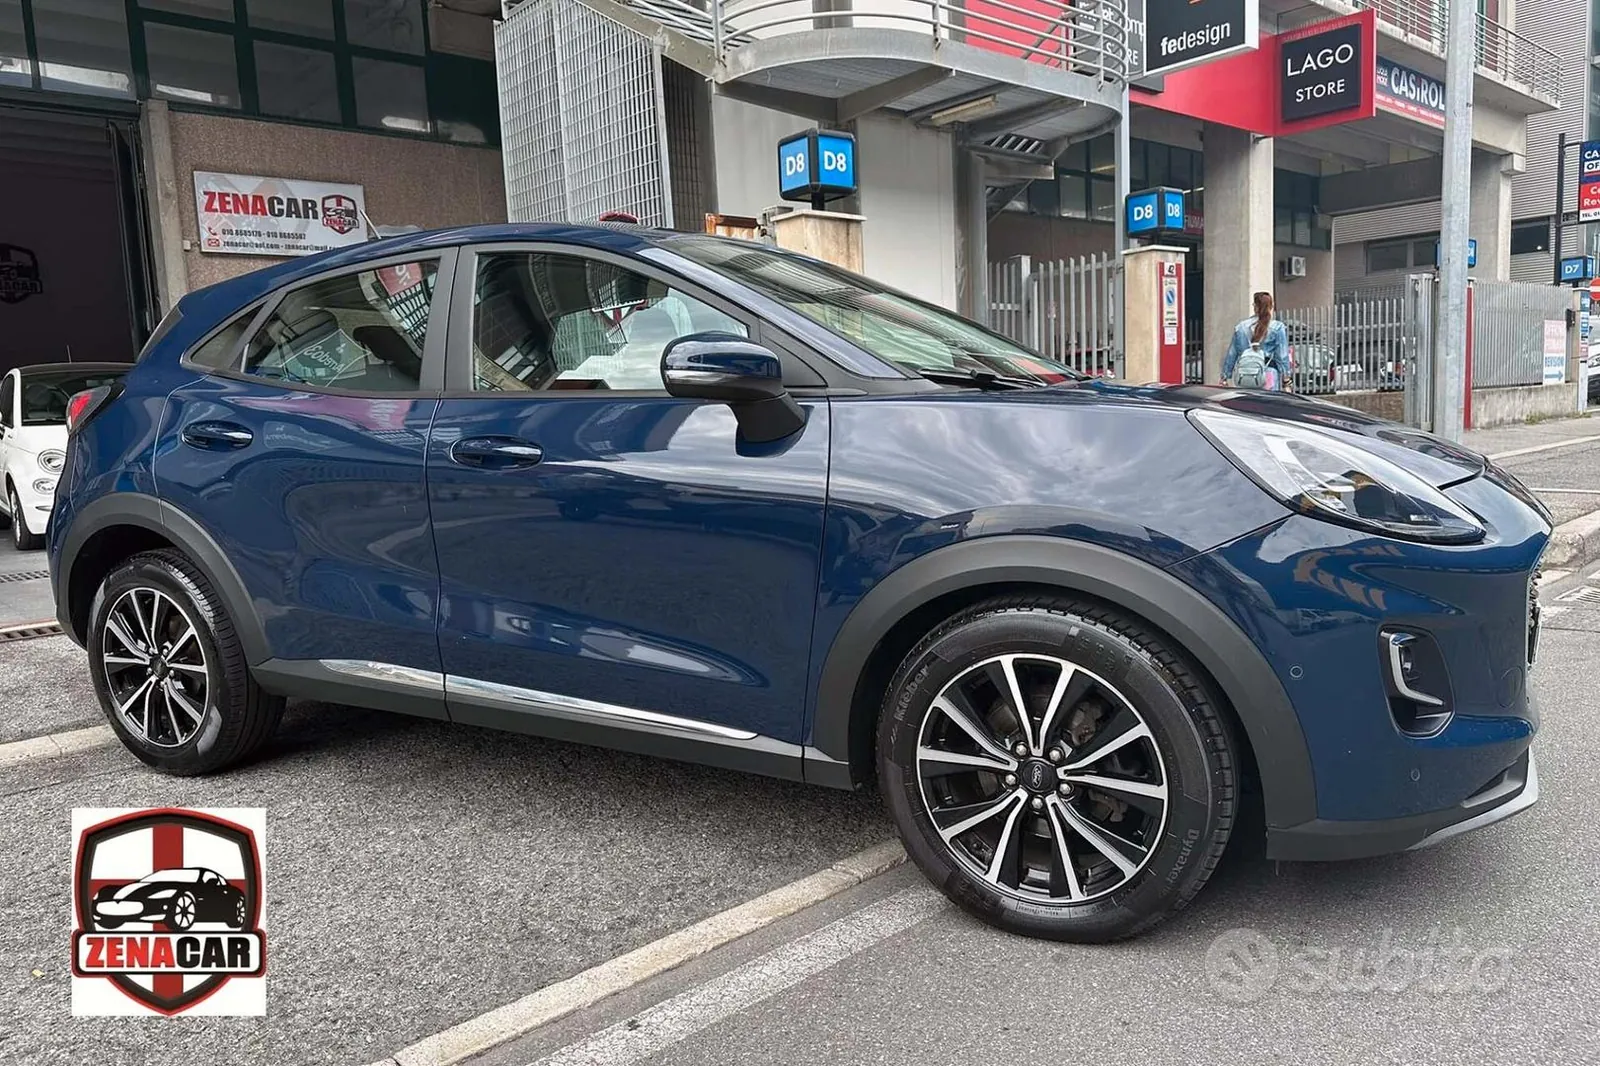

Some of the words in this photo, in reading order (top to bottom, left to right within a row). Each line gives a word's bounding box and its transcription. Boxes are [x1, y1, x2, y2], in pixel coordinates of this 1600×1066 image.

[1160, 21, 1231, 57] fedesign
[1287, 43, 1354, 77] LAGO
[1295, 79, 1346, 103] STORE
[785, 152, 805, 177] D8
[824, 150, 847, 172] D8
[203, 191, 319, 220] ZENACAR
[1133, 204, 1153, 221] D8
[1167, 203, 1180, 218] D8
[1564, 264, 1579, 274] D7
[893, 664, 930, 722] Kleber
[1165, 828, 1200, 884] Dynaxer
